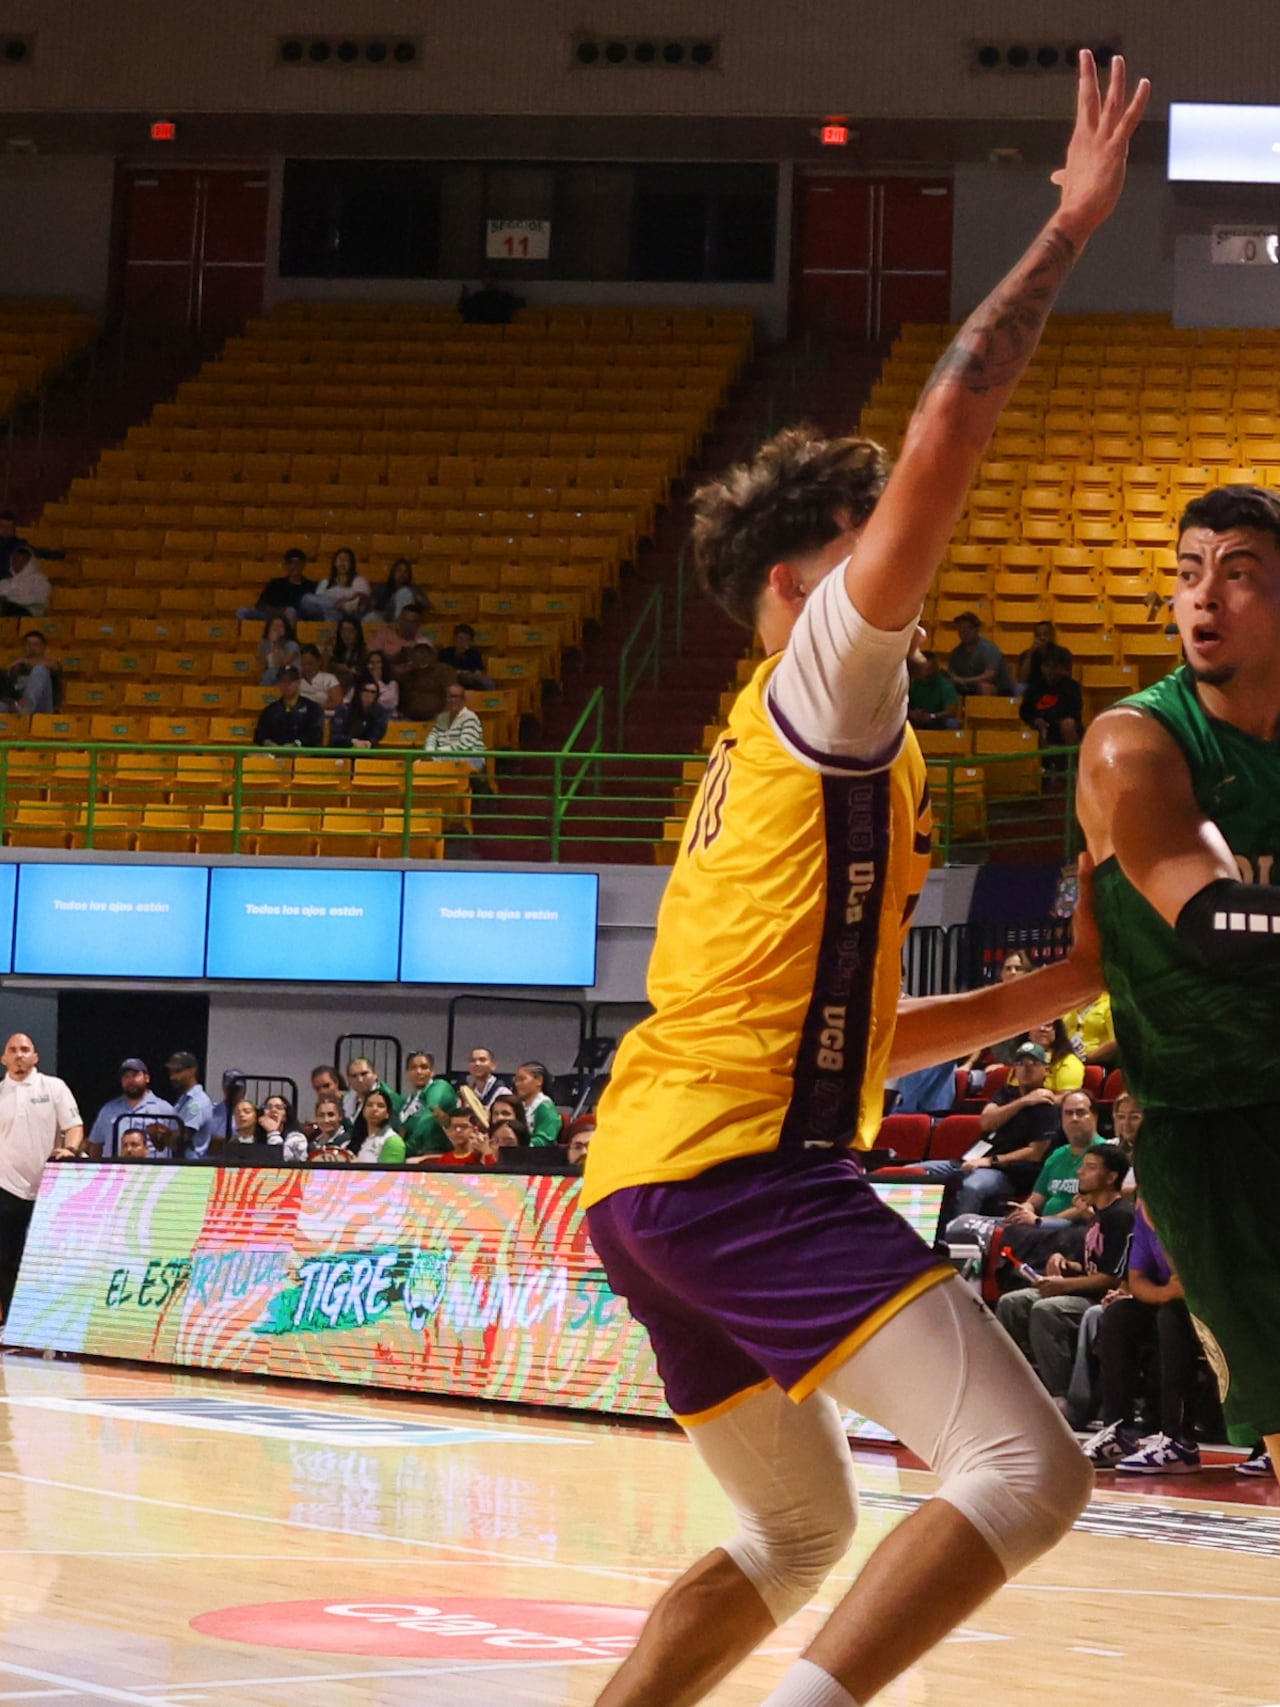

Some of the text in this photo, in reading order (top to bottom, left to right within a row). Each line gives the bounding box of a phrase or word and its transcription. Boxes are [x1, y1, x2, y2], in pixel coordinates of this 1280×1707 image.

[503, 236, 529, 257] 11
[246, 904, 280, 915] Todos
[283, 905, 300, 915] los
[302, 905, 326, 917] ojos
[440, 908, 475, 918] Todos
[477, 909, 494, 919] los
[817, 1005, 847, 1071] UCB
[105, 1267, 132, 1307] EL
[294, 1253, 393, 1327] TIGRE
[441, 1263, 569, 1334] NUNCA
